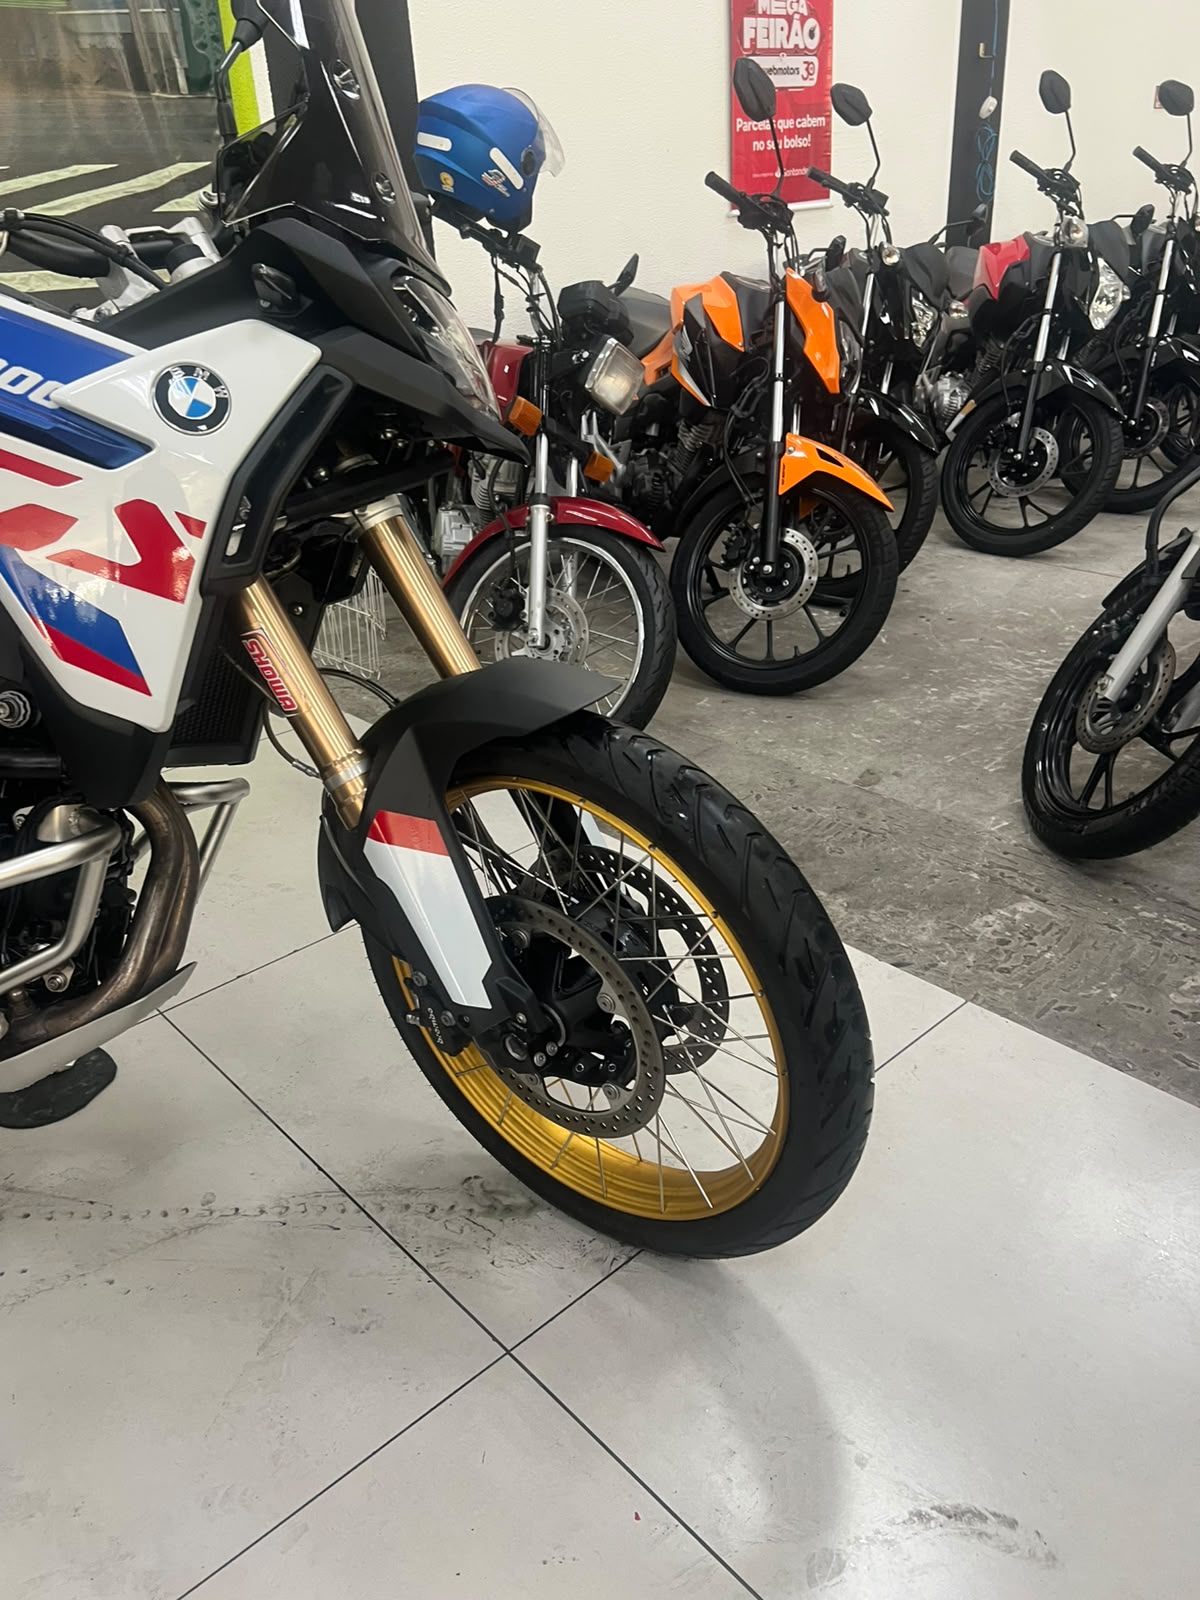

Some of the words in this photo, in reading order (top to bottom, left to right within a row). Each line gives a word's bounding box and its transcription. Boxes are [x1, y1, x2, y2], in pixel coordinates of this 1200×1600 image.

[757, 0, 808, 16] MEGA
[743, 13, 820, 50] FEIRÃO
[777, 118, 795, 133] que
[795, 114, 826, 129] cabem
[752, 141, 765, 151] no
[783, 134, 812, 149] bolso!
[169, 366, 229, 399] BMW
[241, 638, 298, 711] SHOWA
